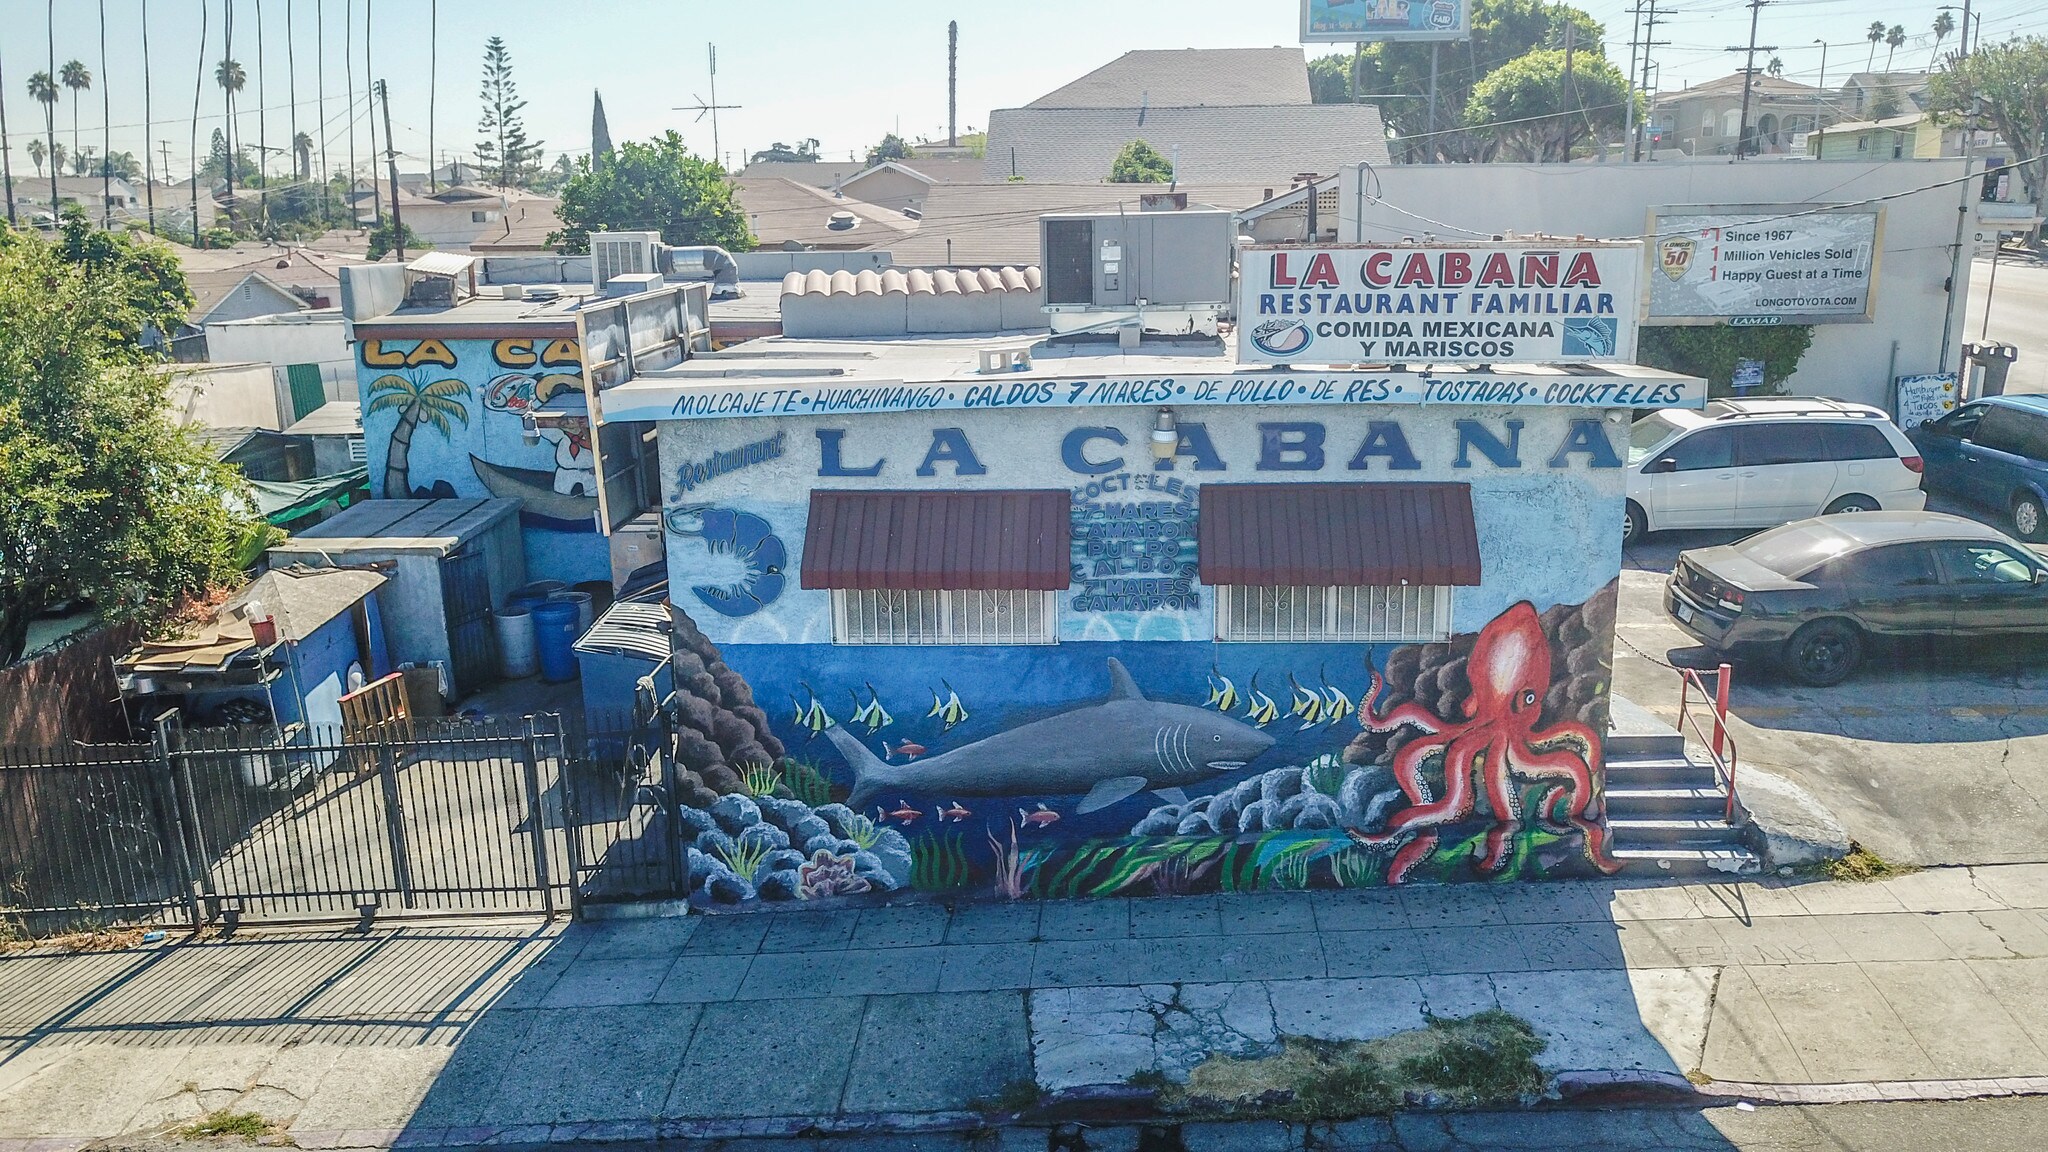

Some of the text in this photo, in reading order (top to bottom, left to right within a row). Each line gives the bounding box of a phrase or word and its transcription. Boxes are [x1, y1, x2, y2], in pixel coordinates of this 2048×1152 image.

[1433, 14, 1451, 24] FAIR
[1725, 230, 1761, 242] Since
[1764, 230, 1794, 241] 1967
[1664, 250, 1689, 266] 50
[1711, 245, 1853, 262] 1 Million Vehicles Sold
[1270, 252, 1340, 290] LA
[1709, 265, 1863, 283] 1 Happy Guest at a Time
[1258, 292, 1615, 315] RESTAURANT FAMILIAR
[1755, 297, 1857, 307] LONGOTOYOTA.COM
[1316, 321, 1555, 338] COMIDA MEXICANA
[1732, 316, 1779, 326] LAMAR
[361, 339, 458, 370] LA
[1360, 340, 1515, 357] Y MARISCOS
[671, 378, 1686, 415] MOLCAJETE HUACHINANGO CALDOS 7 MARES DE POLLO DE RES TOSTADAS COCKTELES
[1910, 400, 1938, 411] Tacos
[815, 427, 987, 477] LA
[670, 430, 785, 502] Restaurant
[1070, 472, 1199, 505] COCTLES
[1084, 501, 1192, 520] 7 MARES
[1070, 521, 1199, 540] CAMARON
[1087, 540, 1180, 558] PULPO
[1070, 557, 1198, 583] CALDOS
[1083, 578, 1192, 597] 7 MARES
[1070, 596, 1200, 612] CAMARON
